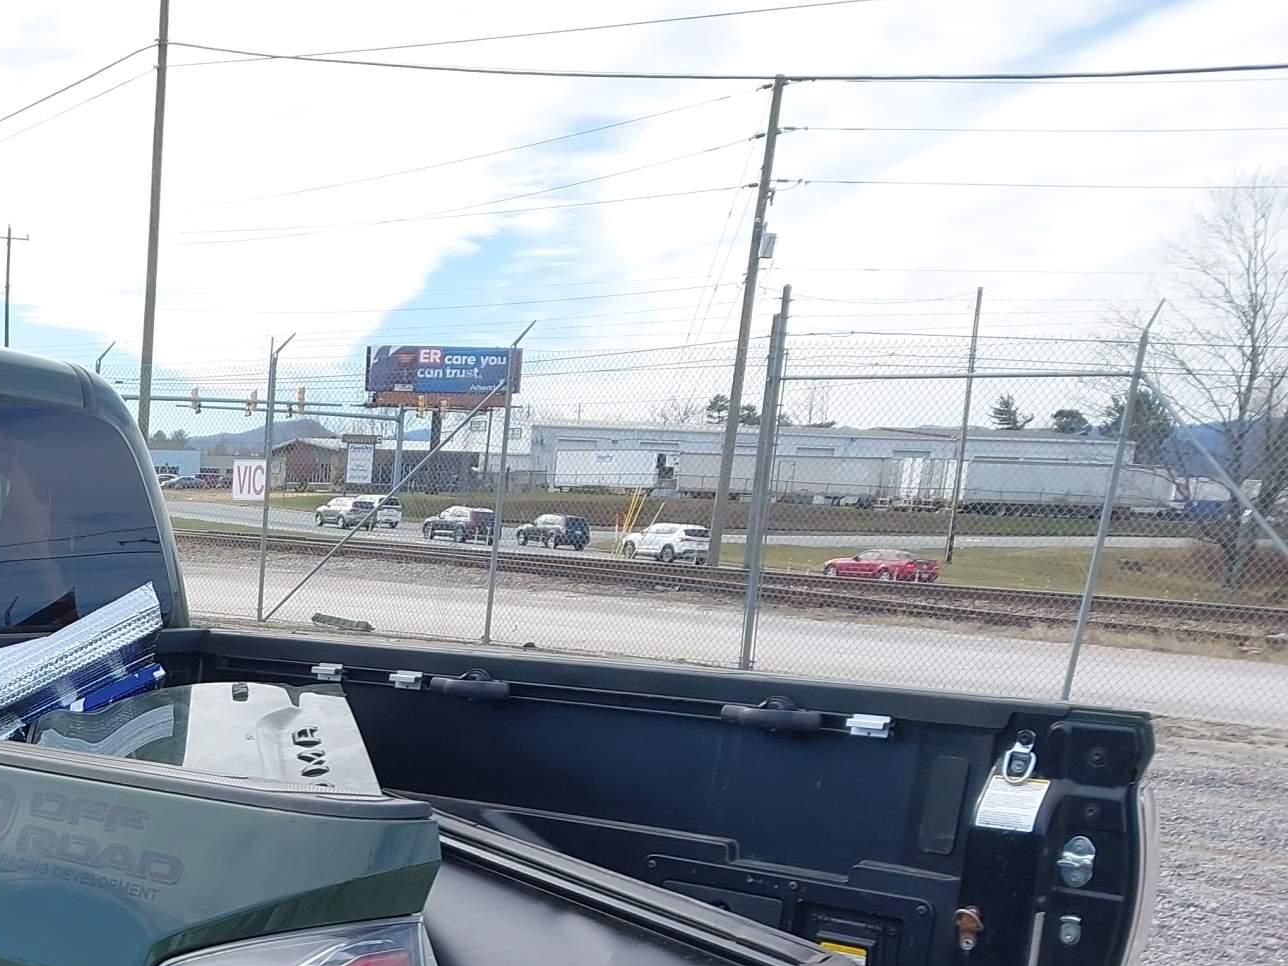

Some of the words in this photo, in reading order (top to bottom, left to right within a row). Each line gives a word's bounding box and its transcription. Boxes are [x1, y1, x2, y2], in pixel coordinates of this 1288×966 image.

[417, 368, 443, 378] can
[419, 349, 442, 363] ER
[445, 355, 477, 365] care
[480, 355, 507, 368] you
[237, 465, 264, 495] VIC
[29, 791, 151, 833] OFF
[15, 824, 186, 887] ROAD
[52, 862, 161, 901] DEVELOPMENT
